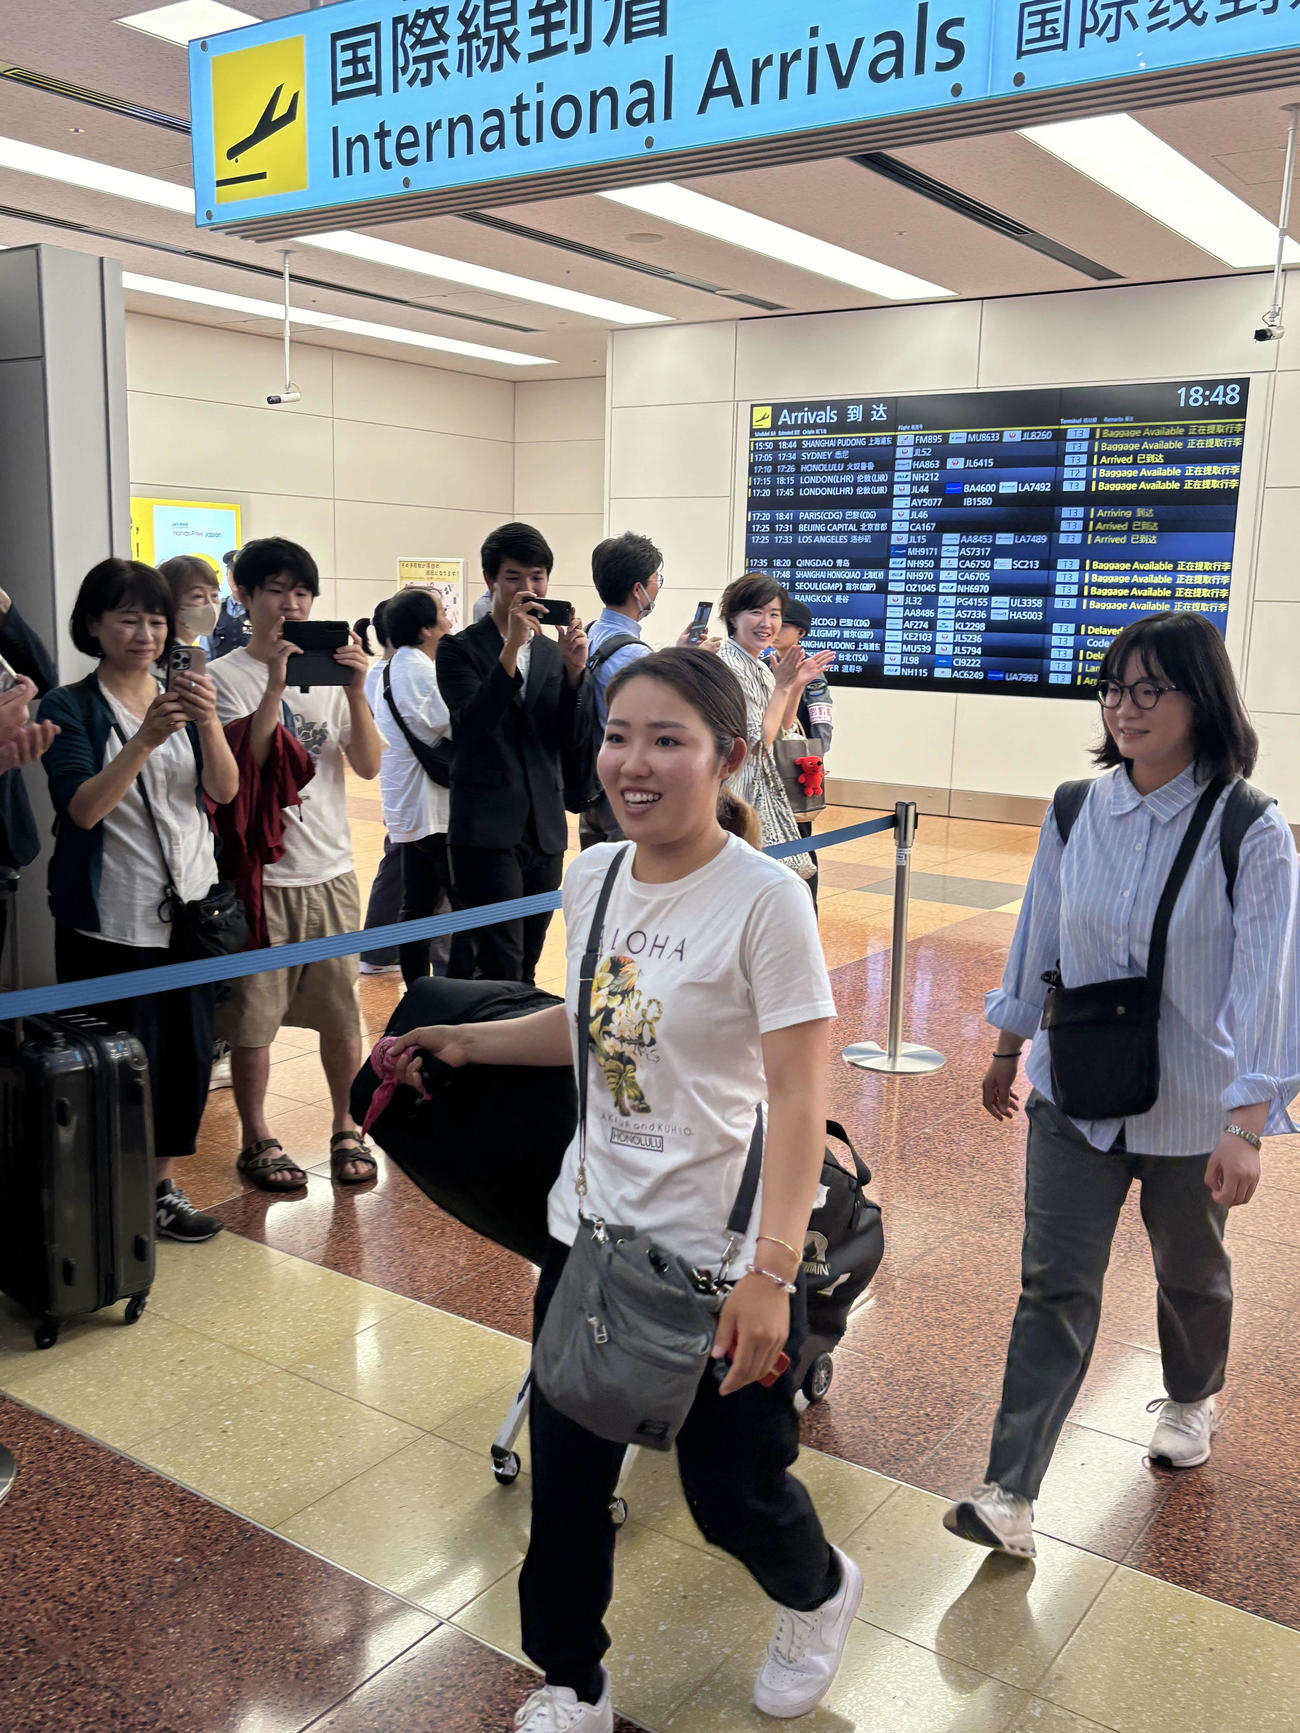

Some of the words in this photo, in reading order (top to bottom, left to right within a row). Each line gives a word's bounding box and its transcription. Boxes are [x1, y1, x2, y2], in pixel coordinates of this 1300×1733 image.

[332, 54, 673, 178] International
[697, 2, 965, 115] Arrivals
[1177, 384, 1240, 407] 18:48
[778, 406, 837, 425] Arrivals
[755, 442, 773, 450] 15:50
[779, 441, 797, 449] 18:44
[802, 440, 835, 448] SHANGHAI
[837, 438, 866, 446] PUDONG
[915, 435, 942, 443] FM895
[968, 433, 999, 441] MU8633
[1102, 429, 1141, 439] Baggage
[1143, 427, 1185, 436] Available
[802, 452, 832, 460] SYDNEY
[1101, 441, 1140, 451] Baggage
[1142, 440, 1183, 449] Available
[801, 463, 844, 472] HONOLULU
[913, 460, 940, 468] HA863
[965, 458, 994, 467] JL6415
[1100, 455, 1132, 464] Arrived
[800, 475, 853, 484] LONDON(LHR)
[912, 473, 939, 481] NH212
[1099, 468, 1138, 478] Baggage
[1140, 467, 1181, 476] Available
[753, 489, 770, 497] 17:20
[800, 486, 853, 496] LONDON(LHR)
[911, 485, 929, 494] JL44
[964, 484, 996, 493] BA4600
[1019, 483, 1051, 492] LA7492
[1098, 481, 1137, 491] Baggage
[1139, 481, 1180, 490] Available
[911, 498, 942, 507] AY5077
[963, 498, 992, 506] IB1580
[752, 513, 770, 521] 17:20
[799, 511, 842, 520] PARIS(CDG)
[910, 511, 928, 519] JL46
[1097, 509, 1132, 518] Arriving
[752, 524, 769, 532] 17:25
[775, 524, 792, 532] 17:31
[799, 524, 826, 532] BEIJING
[910, 523, 936, 531] CA167
[1095, 522, 1128, 530] Arrived
[908, 535, 926, 543] JL15
[960, 535, 993, 543] AA8453
[1015, 535, 1047, 543] LA7489
[1094, 535, 1126, 543] Arrived
[960, 548, 991, 556] AS7317
[750, 559, 767, 567] 17:35
[773, 559, 791, 567] 18:20
[796, 559, 833, 567] QINGDAO
[907, 560, 934, 568] NH950
[959, 560, 991, 568] CA6750
[1013, 561, 1039, 569] SC213
[1092, 561, 1131, 571] Baggage
[1132, 562, 1173, 570] Available
[795, 570, 826, 579] SHANGHAI
[827, 571, 860, 579] HONGQIAO
[906, 572, 933, 580] NH970
[958, 572, 990, 581] CA6705
[1092, 574, 1130, 584] Baggage
[1131, 575, 1172, 583] Available
[795, 582, 842, 591] SEOUL(GMP)
[906, 584, 936, 592] OZ1045
[958, 584, 989, 593] NH6970
[1090, 587, 1129, 597] Baggage
[1130, 588, 1171, 597] Available
[794, 595, 832, 603] BANGKOK
[904, 597, 922, 605] JL32
[957, 598, 988, 606] PG4155
[1011, 599, 1043, 607] UL3358
[1089, 600, 1128, 610] Baggage
[1129, 602, 1170, 610] Available
[904, 609, 934, 617] AA8486
[956, 609, 987, 618] AS7336
[1009, 611, 1043, 620] HA5003
[904, 621, 928, 629] AF274
[955, 622, 985, 631] KL2298
[903, 632, 932, 641] KE2103
[954, 634, 982, 643] JL5236
[827, 641, 855, 649] PUDONG
[903, 645, 931, 653] MU539
[954, 646, 982, 655] JL5794
[901, 656, 919, 665] JL98
[902, 668, 928, 676] NH115
[952, 671, 984, 680] AC6249
[600, 925, 686, 961] LOHA
[613, 1130, 661, 1148] HONOLULU
